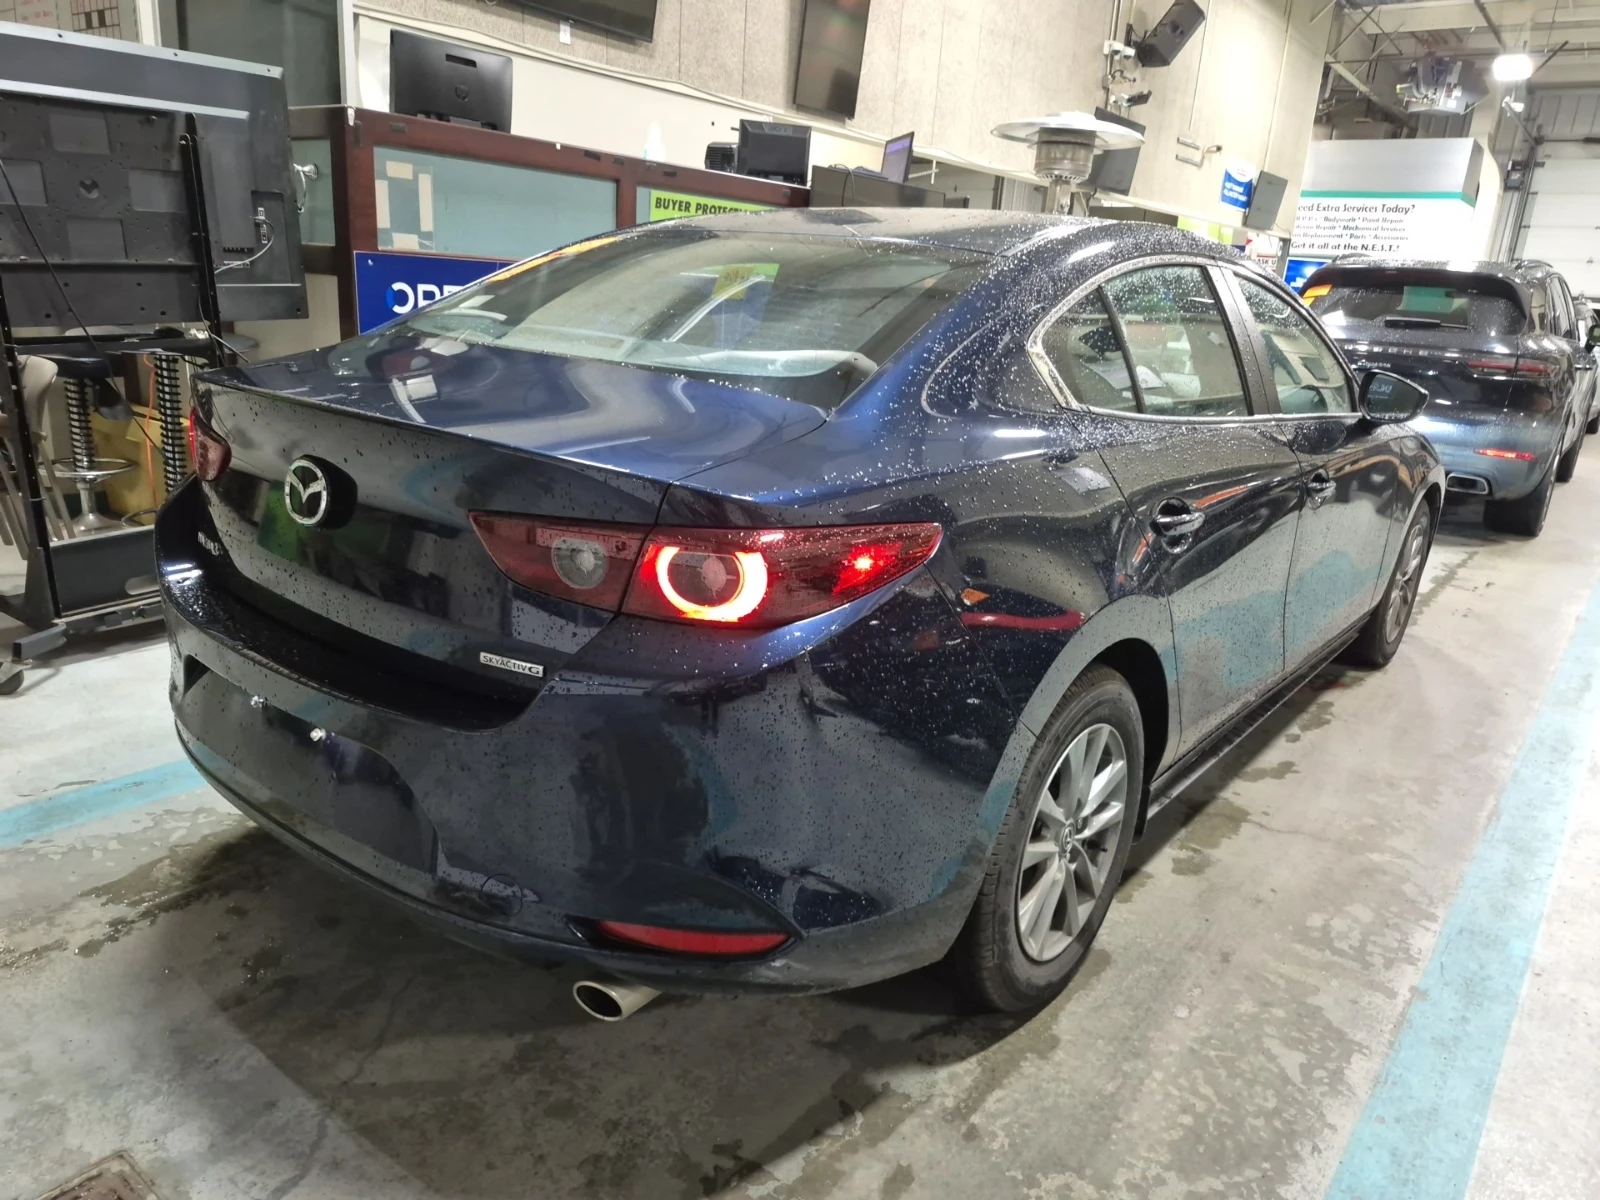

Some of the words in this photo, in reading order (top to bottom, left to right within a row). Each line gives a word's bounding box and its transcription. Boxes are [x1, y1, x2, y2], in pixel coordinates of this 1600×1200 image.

[655, 197, 692, 213] BUYER
[1298, 203, 1315, 212] eed
[1316, 203, 1340, 212] Extra
[1343, 203, 1378, 213] Services
[1381, 204, 1416, 215] Today?
[1291, 241, 1306, 249] Get
[1317, 242, 1330, 250] all
[1331, 242, 1341, 250] at
[1343, 242, 1359, 251] the
